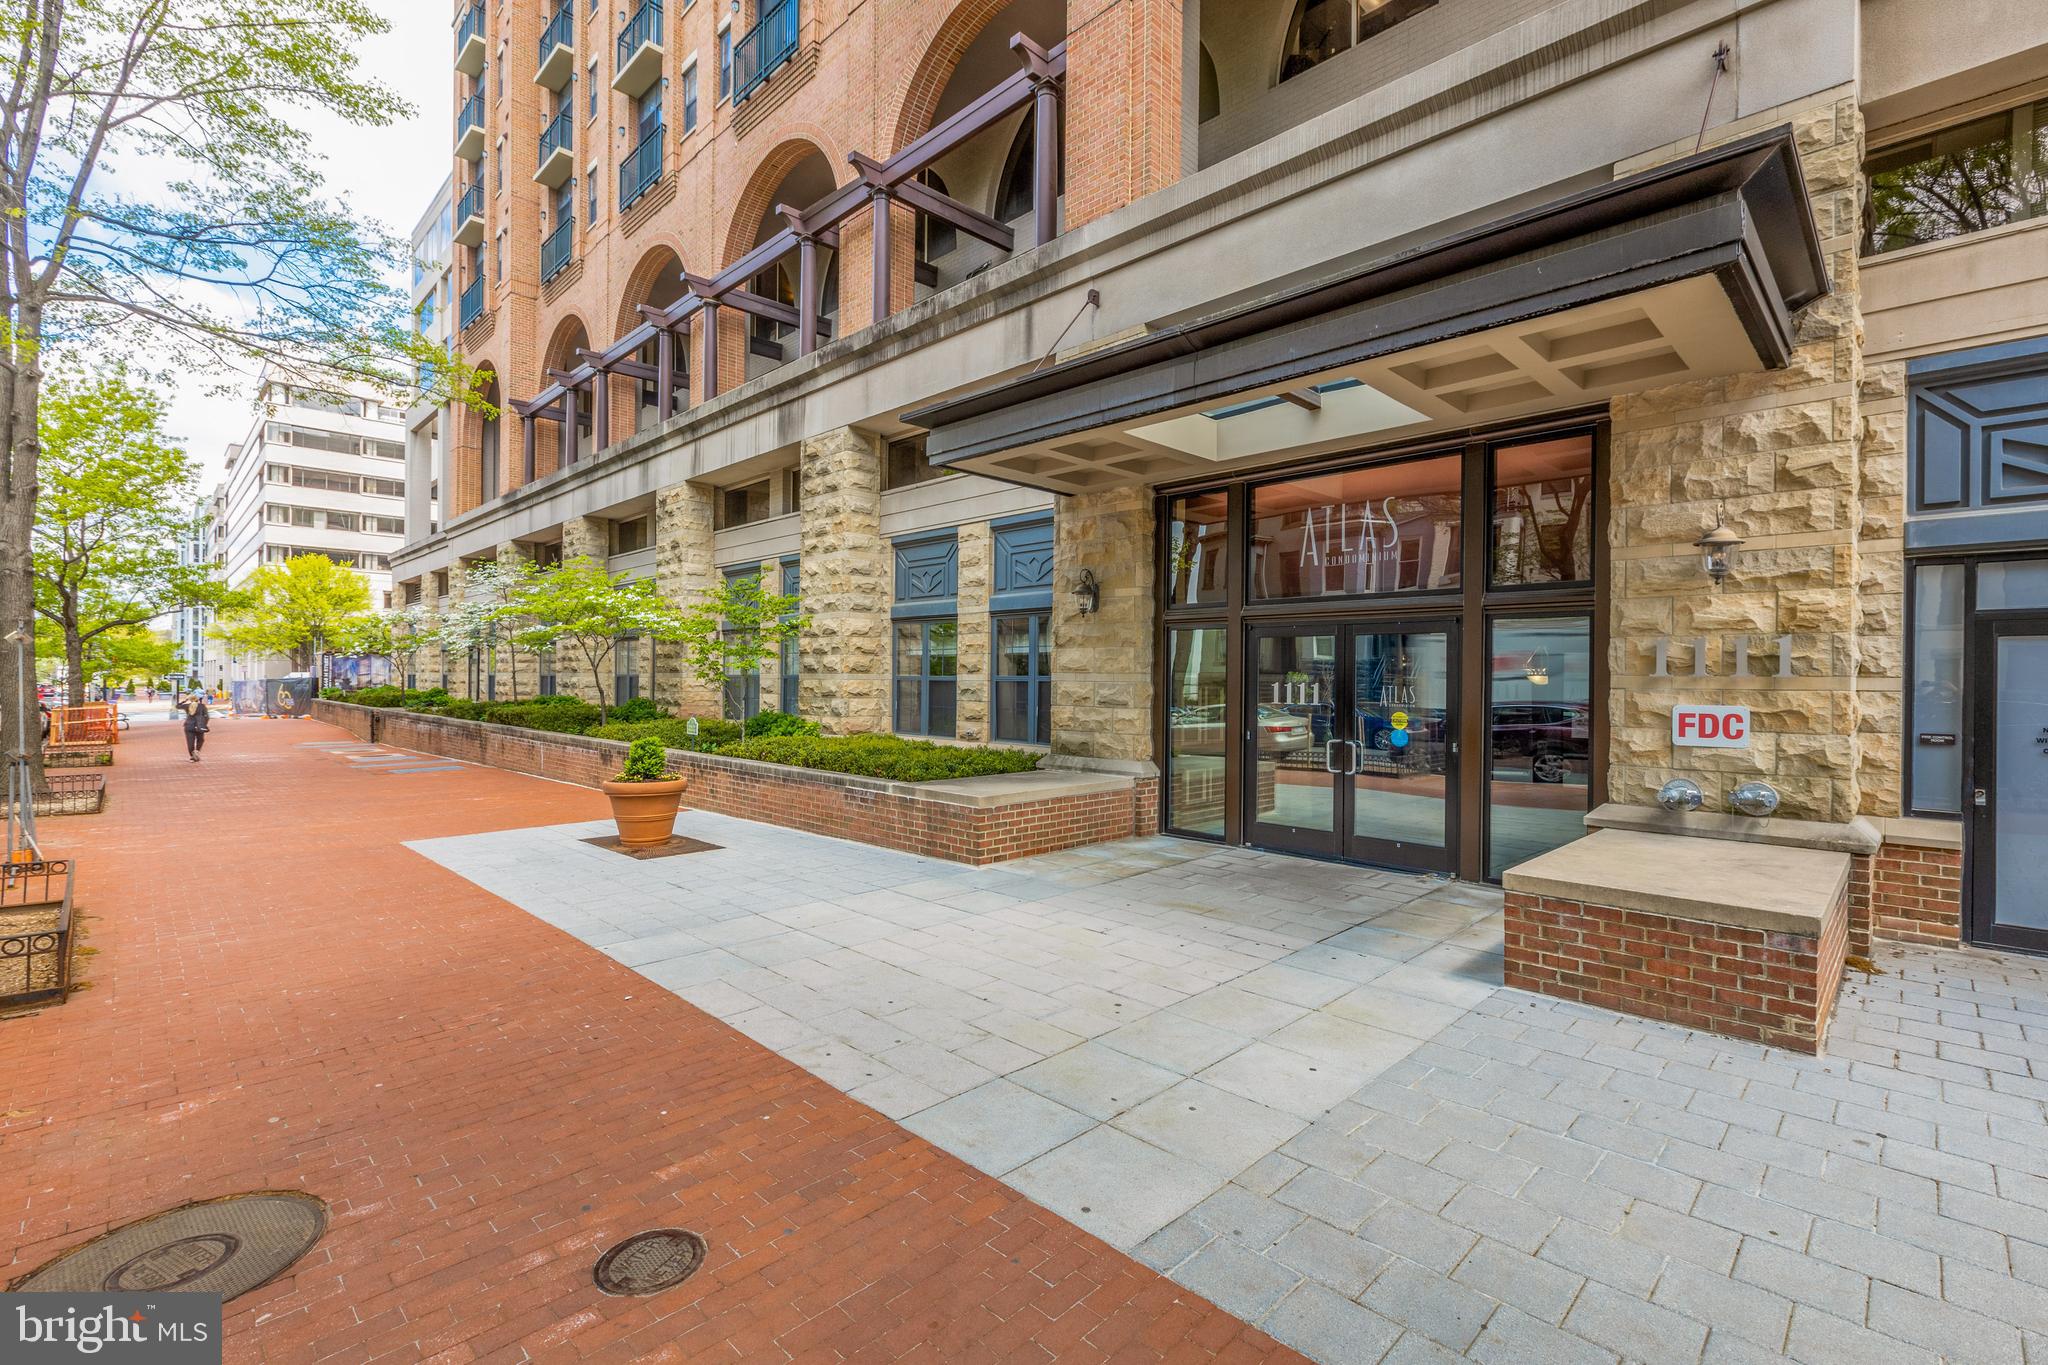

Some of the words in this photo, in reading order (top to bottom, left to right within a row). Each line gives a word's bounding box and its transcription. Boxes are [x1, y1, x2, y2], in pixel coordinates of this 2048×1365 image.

[1300, 496, 1398, 567] ATLAS
[1324, 550, 1399, 566] CONDOMINIUM
[1649, 634, 1797, 677] 1111
[1271, 682, 1321, 706] 1111
[1380, 685, 1416, 707] ATLAS
[1678, 713, 1744, 740] FDC
[611, 1240, 661, 1274] WATER
